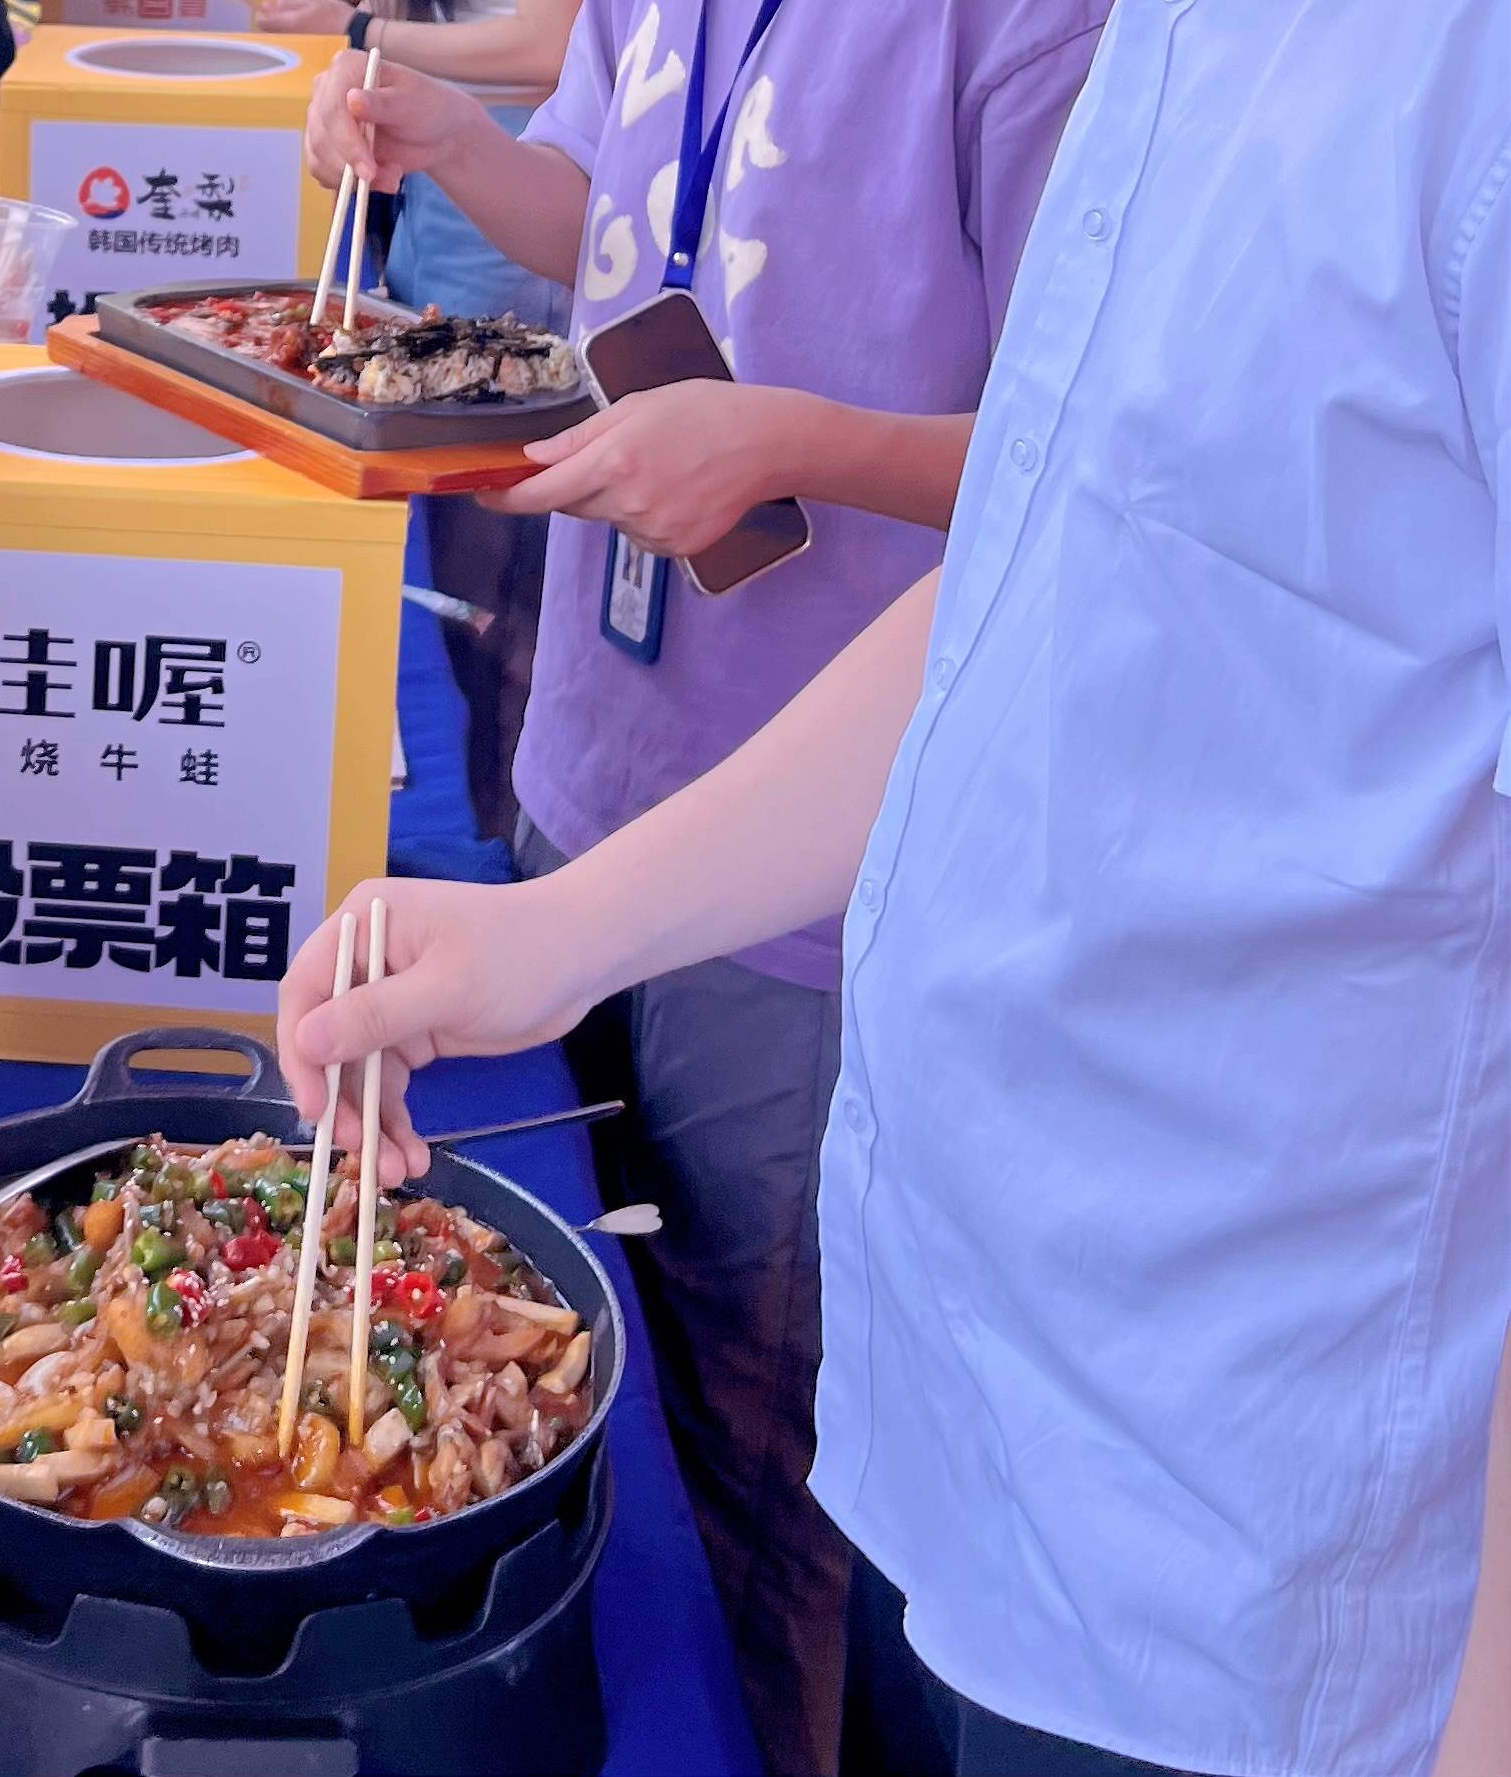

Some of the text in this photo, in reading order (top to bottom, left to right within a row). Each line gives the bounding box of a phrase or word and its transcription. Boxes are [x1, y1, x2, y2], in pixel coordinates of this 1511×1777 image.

[87, 229, 240, 258] 韩国传统烤肉
